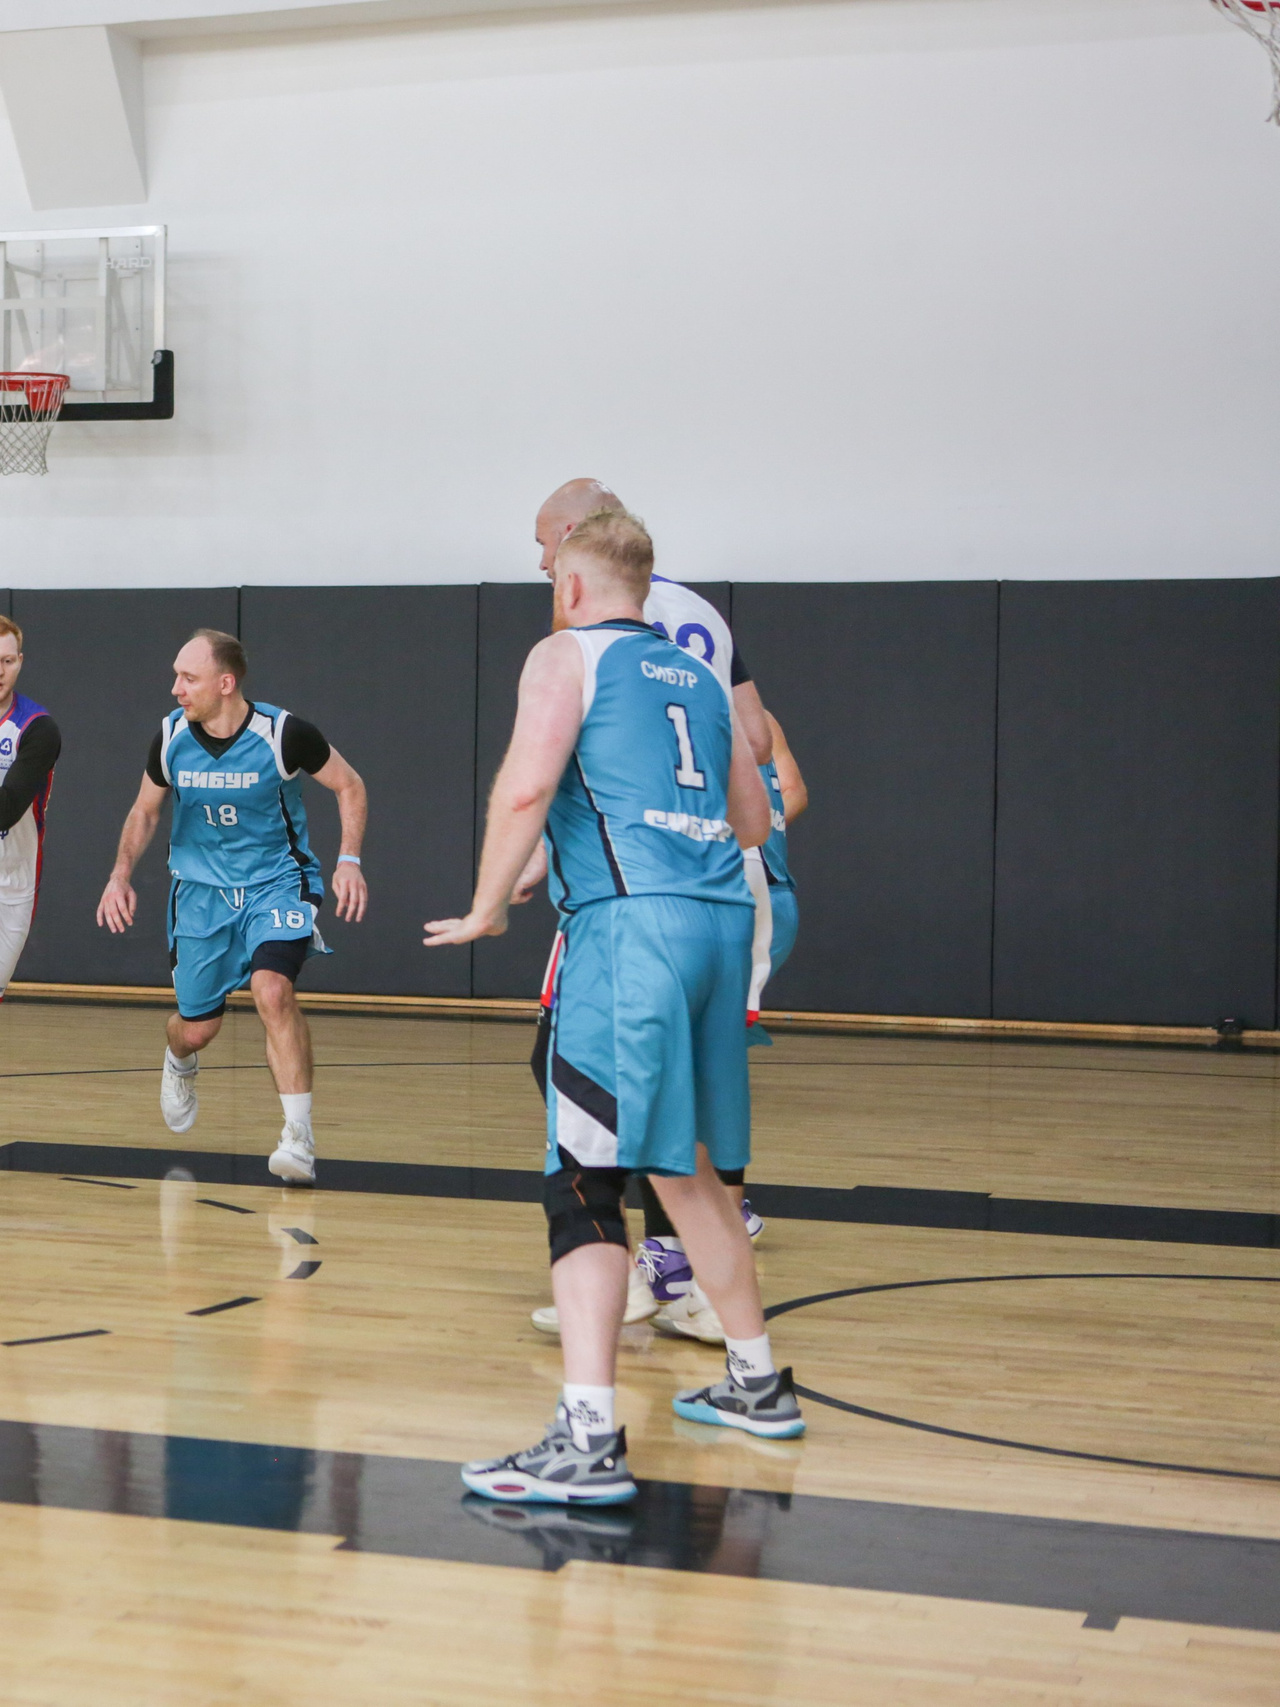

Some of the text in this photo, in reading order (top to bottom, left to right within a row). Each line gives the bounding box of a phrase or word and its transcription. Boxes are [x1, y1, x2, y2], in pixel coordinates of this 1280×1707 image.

[105, 256, 152, 269] HARD
[640, 660, 698, 688] СИБУР
[665, 702, 707, 791] 1
[178, 770, 259, 789] СИБУР
[203, 803, 239, 827] 18
[270, 908, 305, 929] 18
